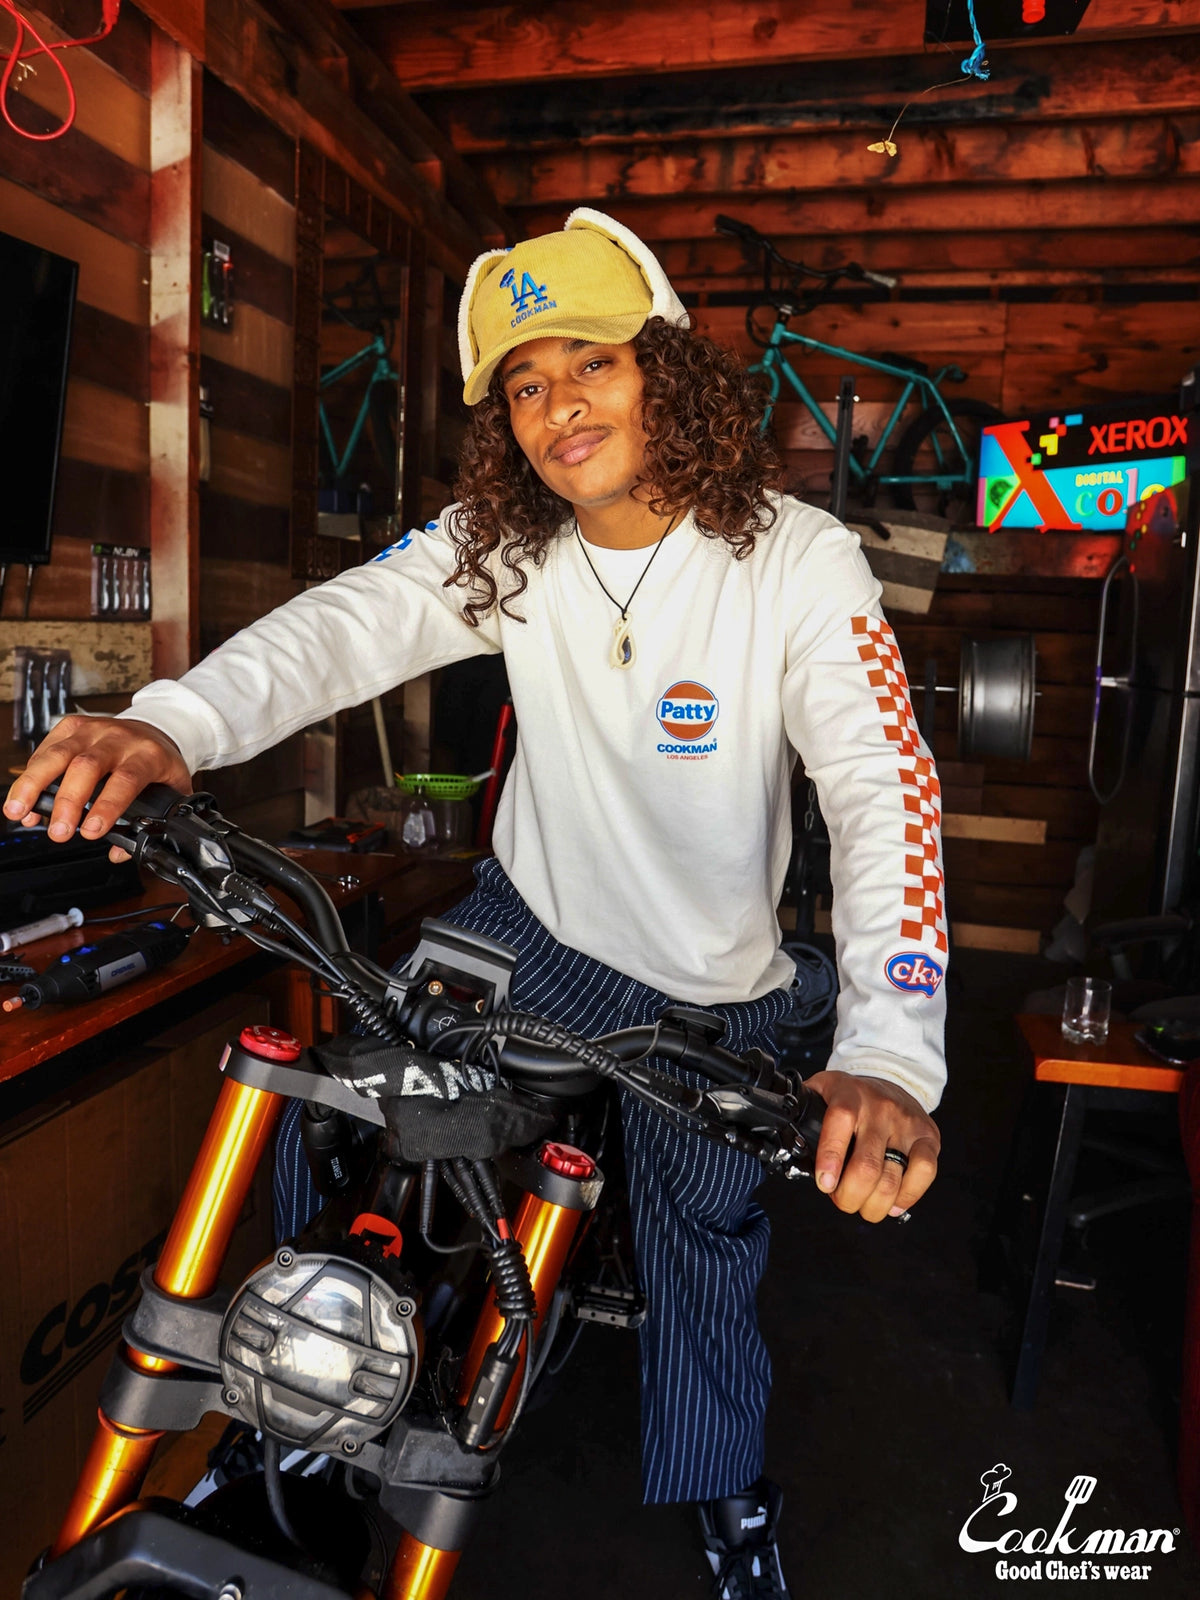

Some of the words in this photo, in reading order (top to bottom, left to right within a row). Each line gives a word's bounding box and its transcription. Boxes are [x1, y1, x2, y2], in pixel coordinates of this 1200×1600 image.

[510, 271, 548, 313] LA
[510, 300, 557, 328] COOKMAN
[1088, 415, 1188, 455] XEROX
[1075, 471, 1123, 487] DIGITAL
[661, 700, 716, 721] Patty
[657, 742, 718, 754] COOKMAN
